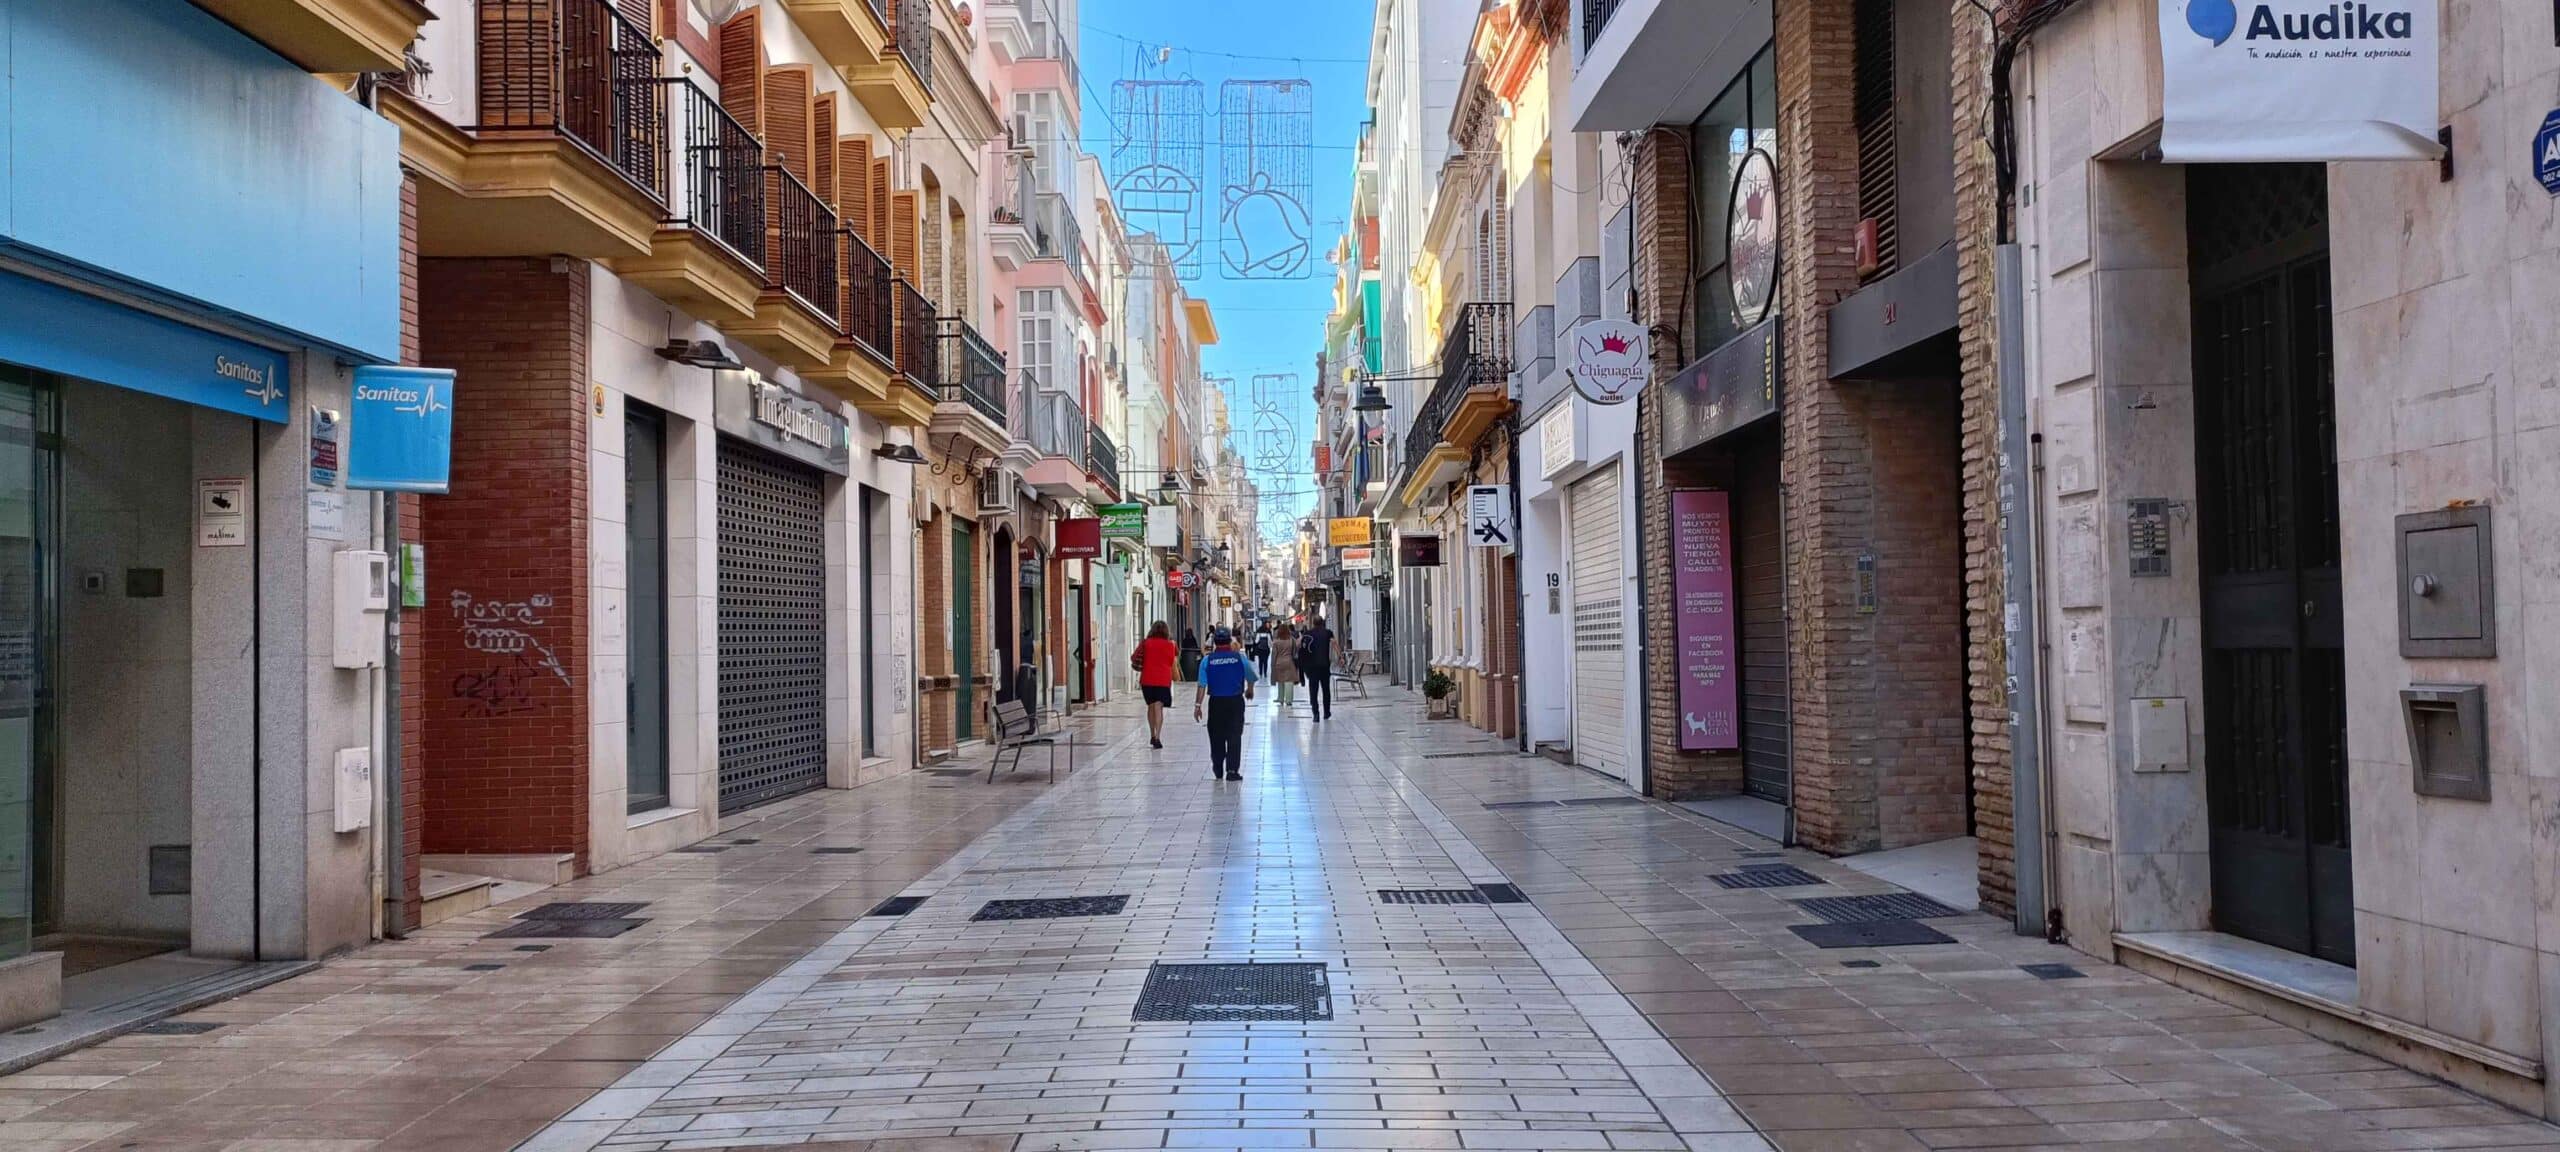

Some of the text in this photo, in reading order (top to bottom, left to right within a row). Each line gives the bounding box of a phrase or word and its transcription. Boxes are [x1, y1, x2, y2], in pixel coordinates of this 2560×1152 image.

[2246, 1, 2411, 40] Audika
[2247, 48, 2259, 58] Tu
[2265, 49, 2302, 58] audición
[2325, 46, 2358, 58] nuestra
[2364, 48, 2411, 60] experiencia
[216, 355, 263, 385] Sanitas
[1579, 363, 1642, 379] Chiguagua
[356, 385, 418, 402] Sanitas
[757, 386, 831, 449] Imaginarium
[1547, 573, 1559, 587] 19
